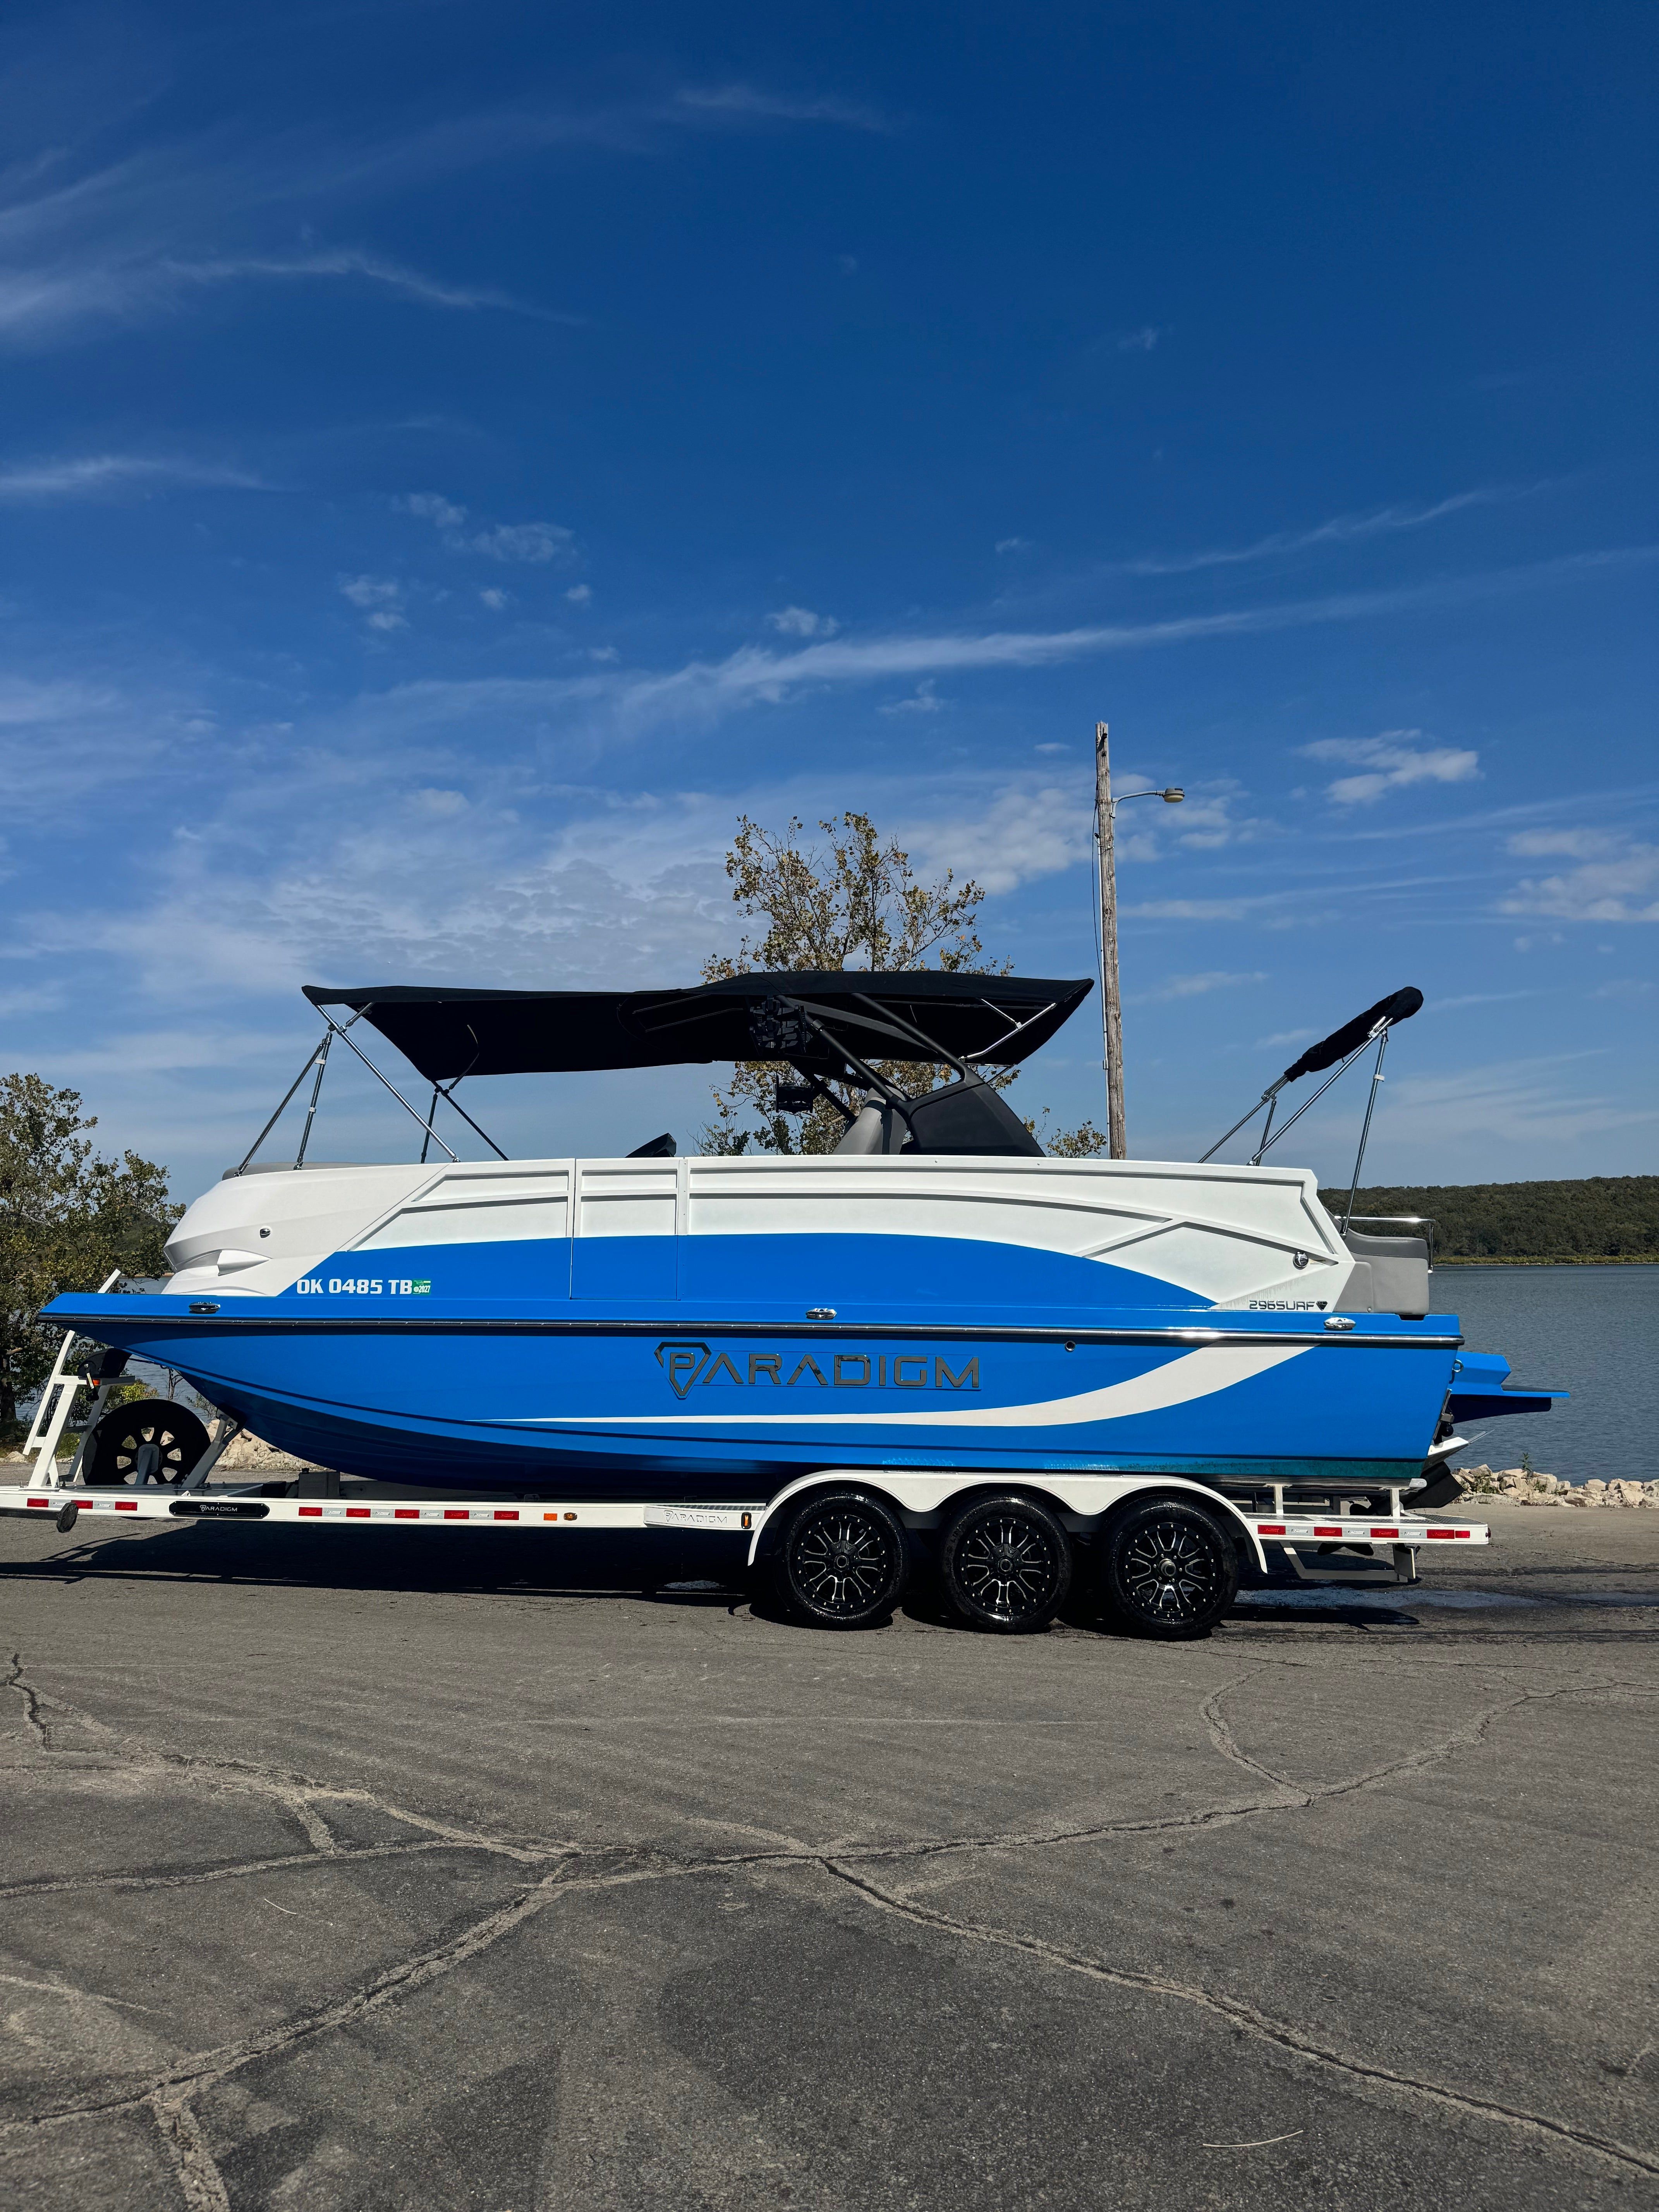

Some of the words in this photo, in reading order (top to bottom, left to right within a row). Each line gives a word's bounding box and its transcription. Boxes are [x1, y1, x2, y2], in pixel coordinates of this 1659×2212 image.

[297, 1279, 324, 1294] OK
[329, 1278, 383, 1294] 0485
[388, 1279, 412, 1294] TB
[418, 1285, 431, 1293] 2027
[1249, 1299, 1315, 1310] 296SURF
[654, 1341, 980, 1396] PARADIGM
[663, 1510, 727, 1524] PARADIGM
